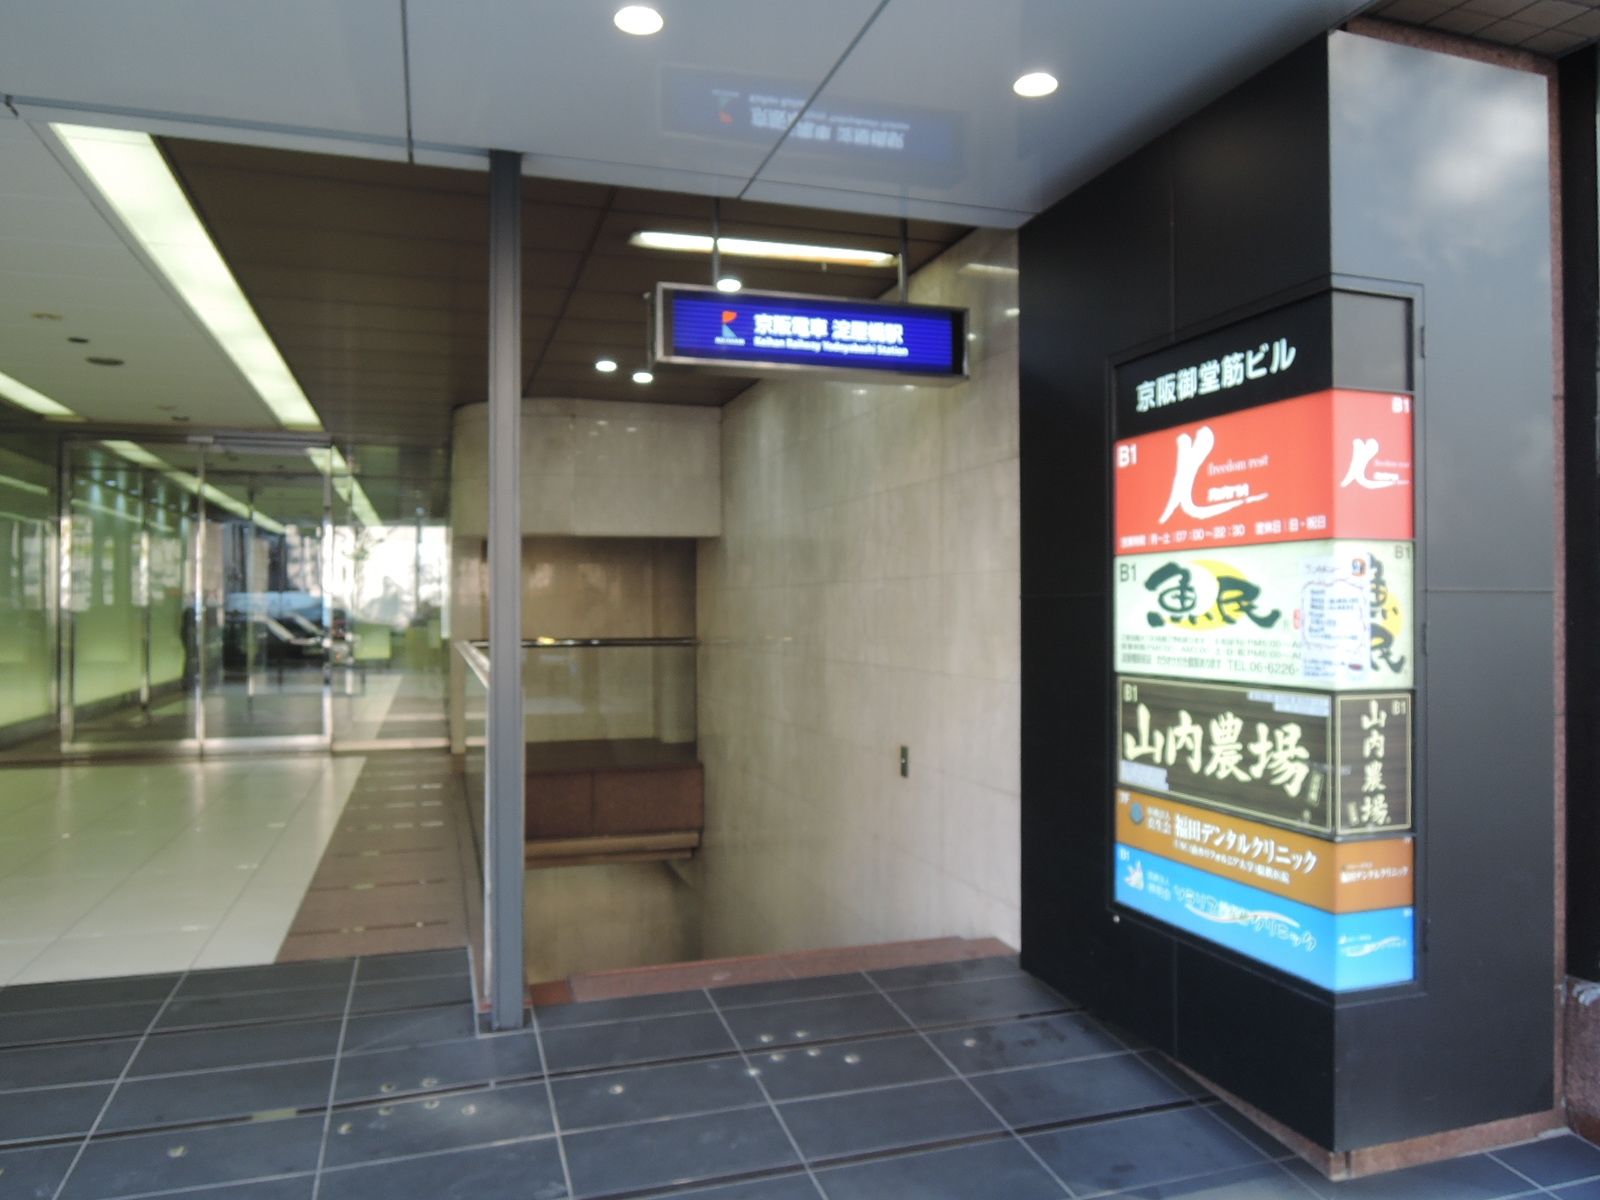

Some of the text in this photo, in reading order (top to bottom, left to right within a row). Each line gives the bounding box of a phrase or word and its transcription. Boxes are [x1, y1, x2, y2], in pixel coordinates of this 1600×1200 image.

[1136, 338, 1296, 412] 京阪御堂筋ビル
[1392, 396, 1410, 414] B1
[1117, 444, 1137, 468] B1
[1208, 459, 1246, 476] freedom
[1394, 545, 1411, 560] B1
[1120, 563, 1137, 582] B1
[1144, 561, 1282, 629] 魚民
[1124, 683, 1138, 702] B1
[1391, 700, 1406, 715] B1
[1123, 703, 1310, 797] 山内農場
[1361, 699, 1388, 825] 山内農場
